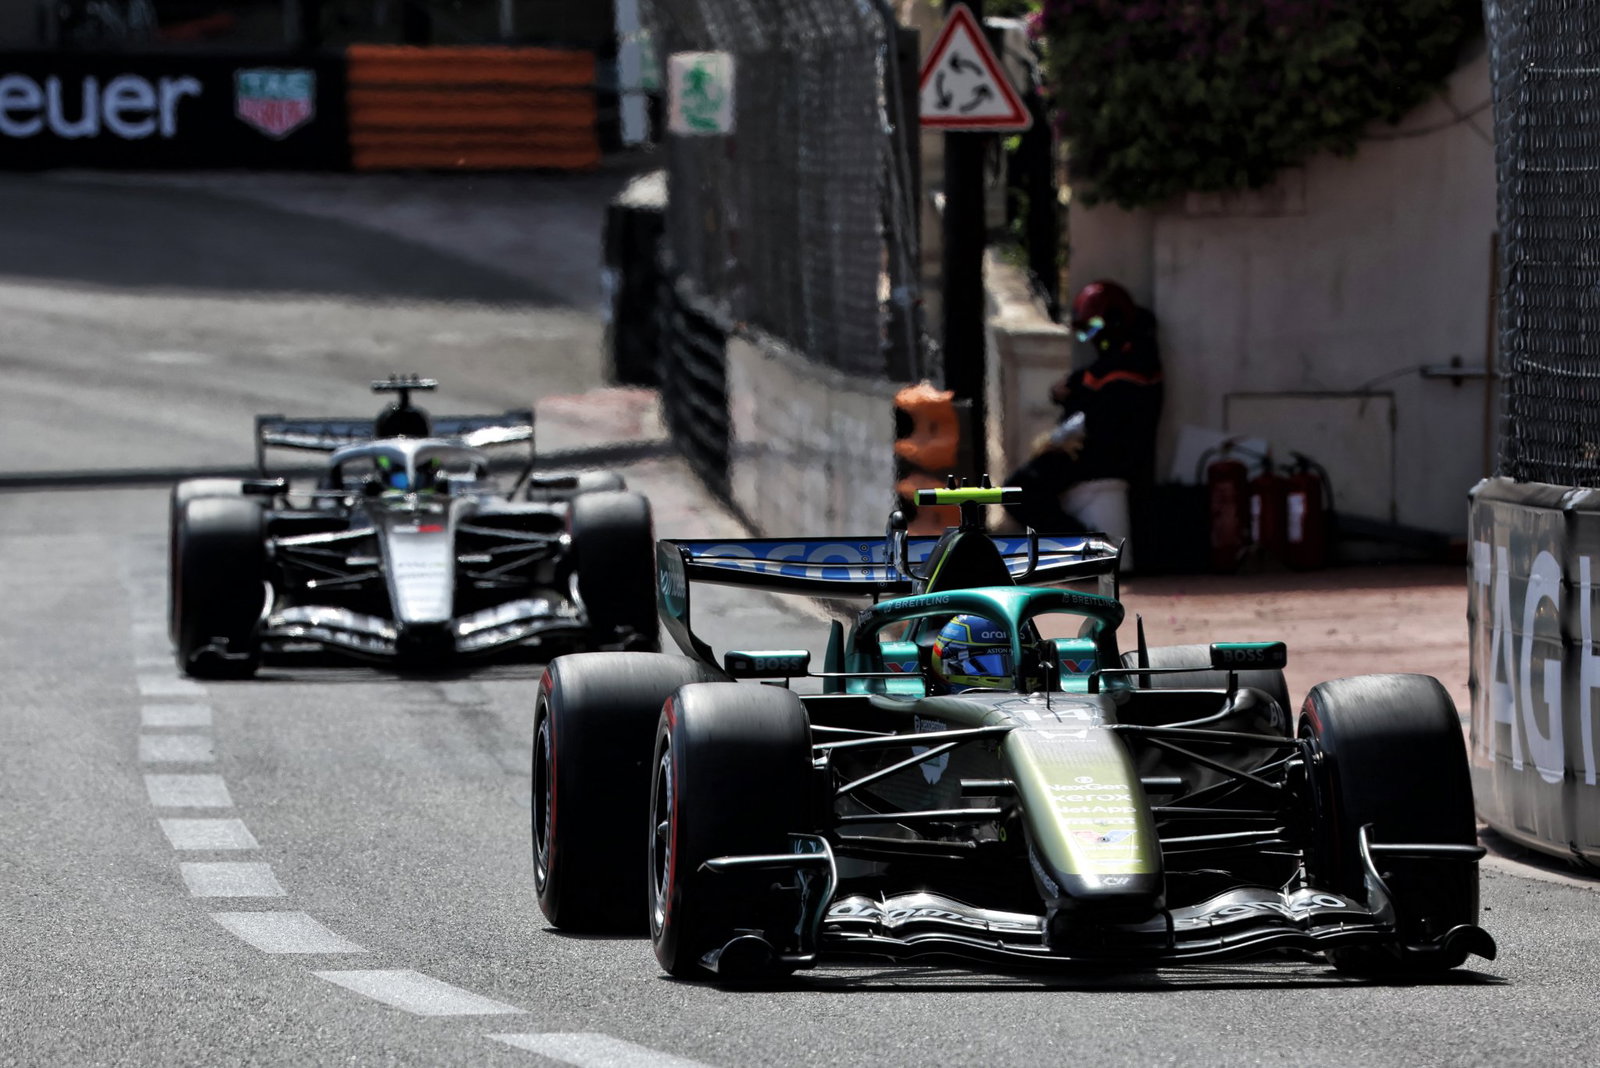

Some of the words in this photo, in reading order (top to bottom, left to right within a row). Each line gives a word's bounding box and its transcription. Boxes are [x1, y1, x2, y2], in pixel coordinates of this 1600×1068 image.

[0, 72, 203, 139] euer
[894, 595, 950, 609] BREITLING
[986, 647, 1008, 655] ASTON
[1223, 648, 1265, 662] BOSS
[754, 657, 800, 671] BOSS
[1012, 708, 1091, 721] 14
[1051, 794, 1132, 803] xerox
